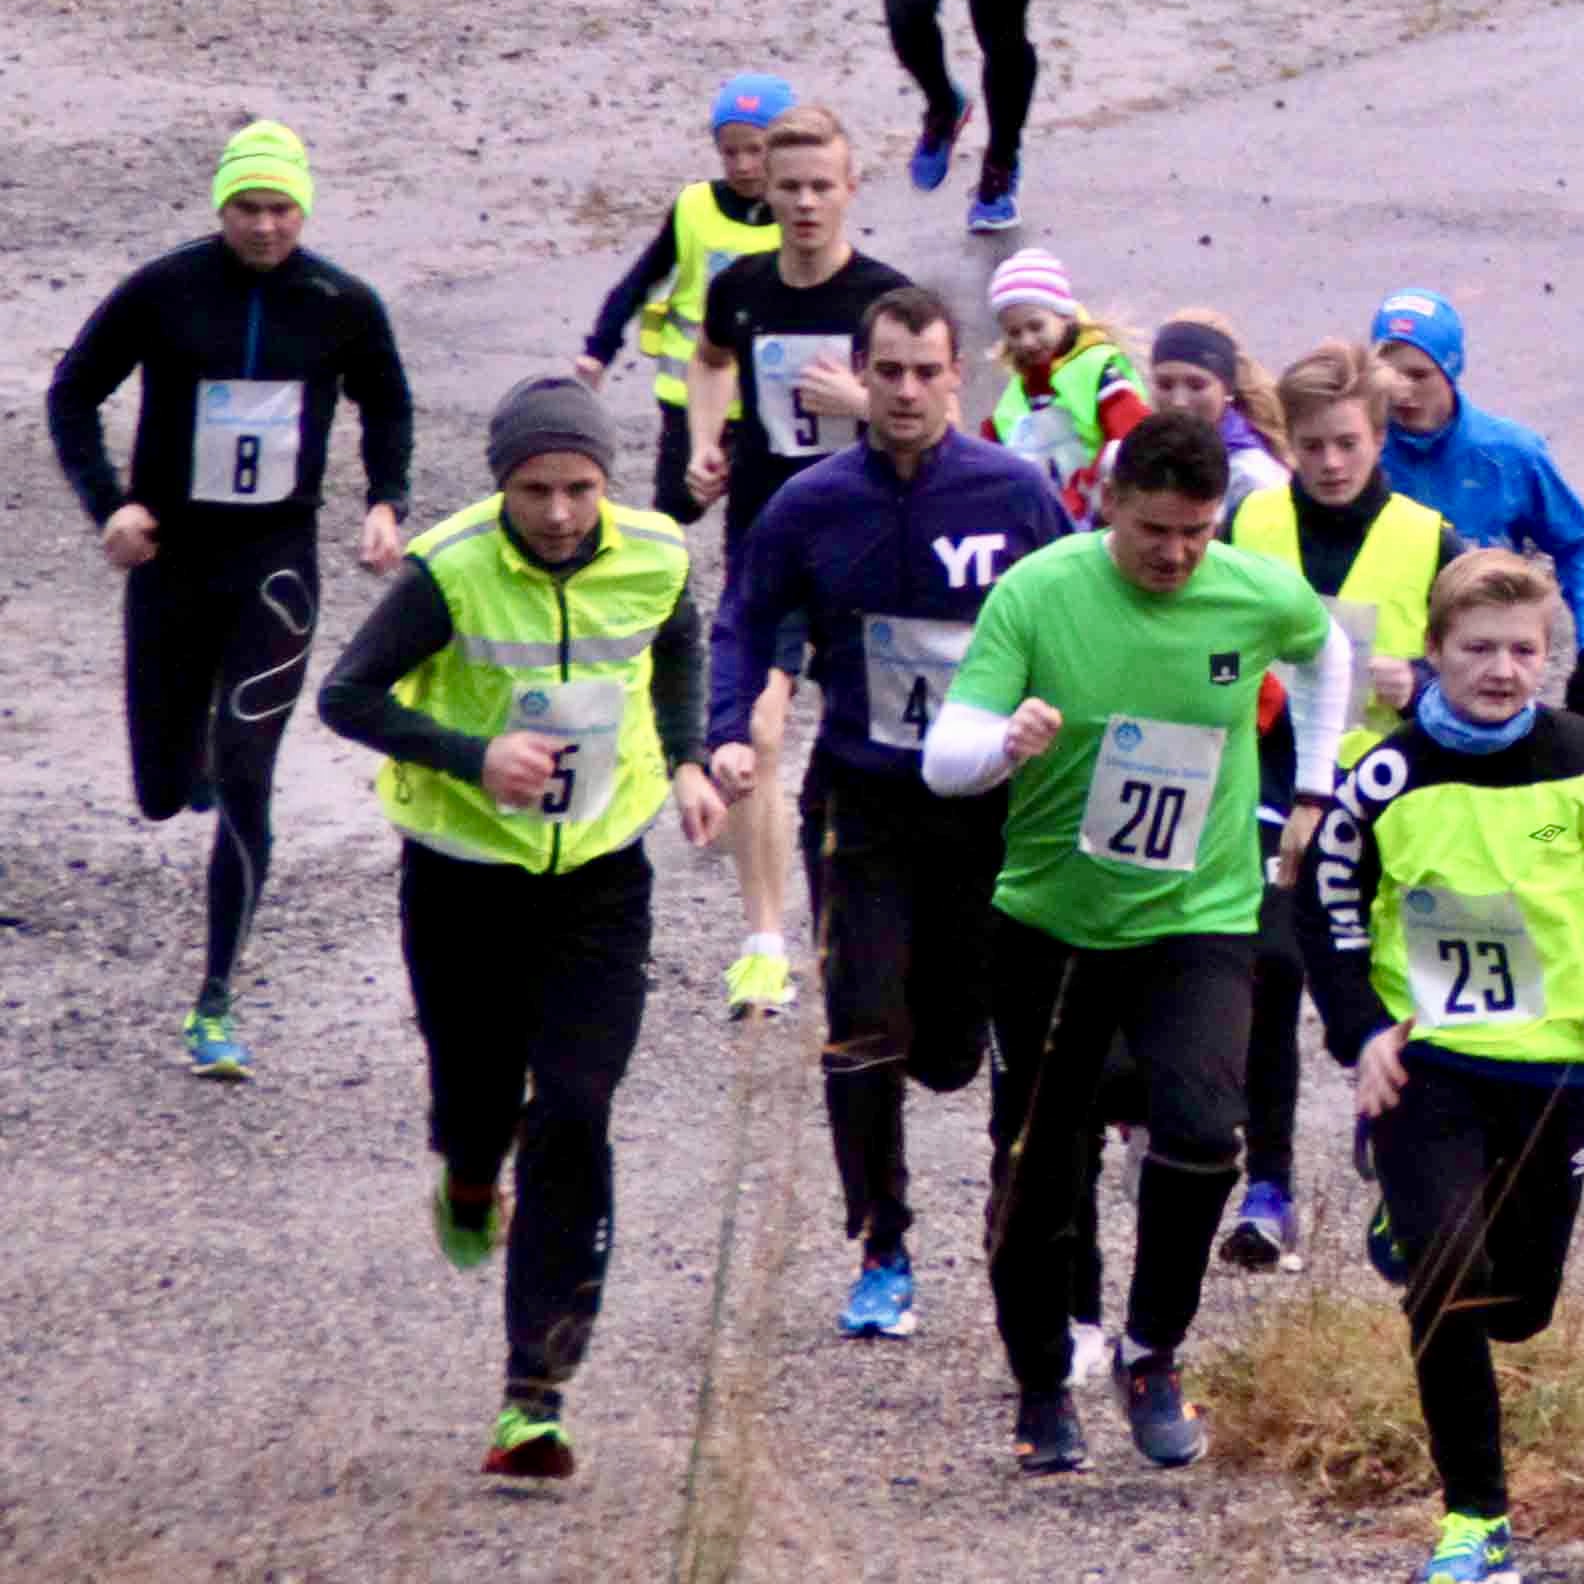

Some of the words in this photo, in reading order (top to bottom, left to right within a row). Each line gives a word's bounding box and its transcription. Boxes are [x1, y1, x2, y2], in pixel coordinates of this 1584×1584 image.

[234, 434, 261, 495] 8
[932, 532, 1006, 588] YT
[902, 675, 931, 742] 4
[541, 743, 580, 814] 5
[1107, 779, 1188, 860] 20
[1437, 939, 1517, 1015] 23
